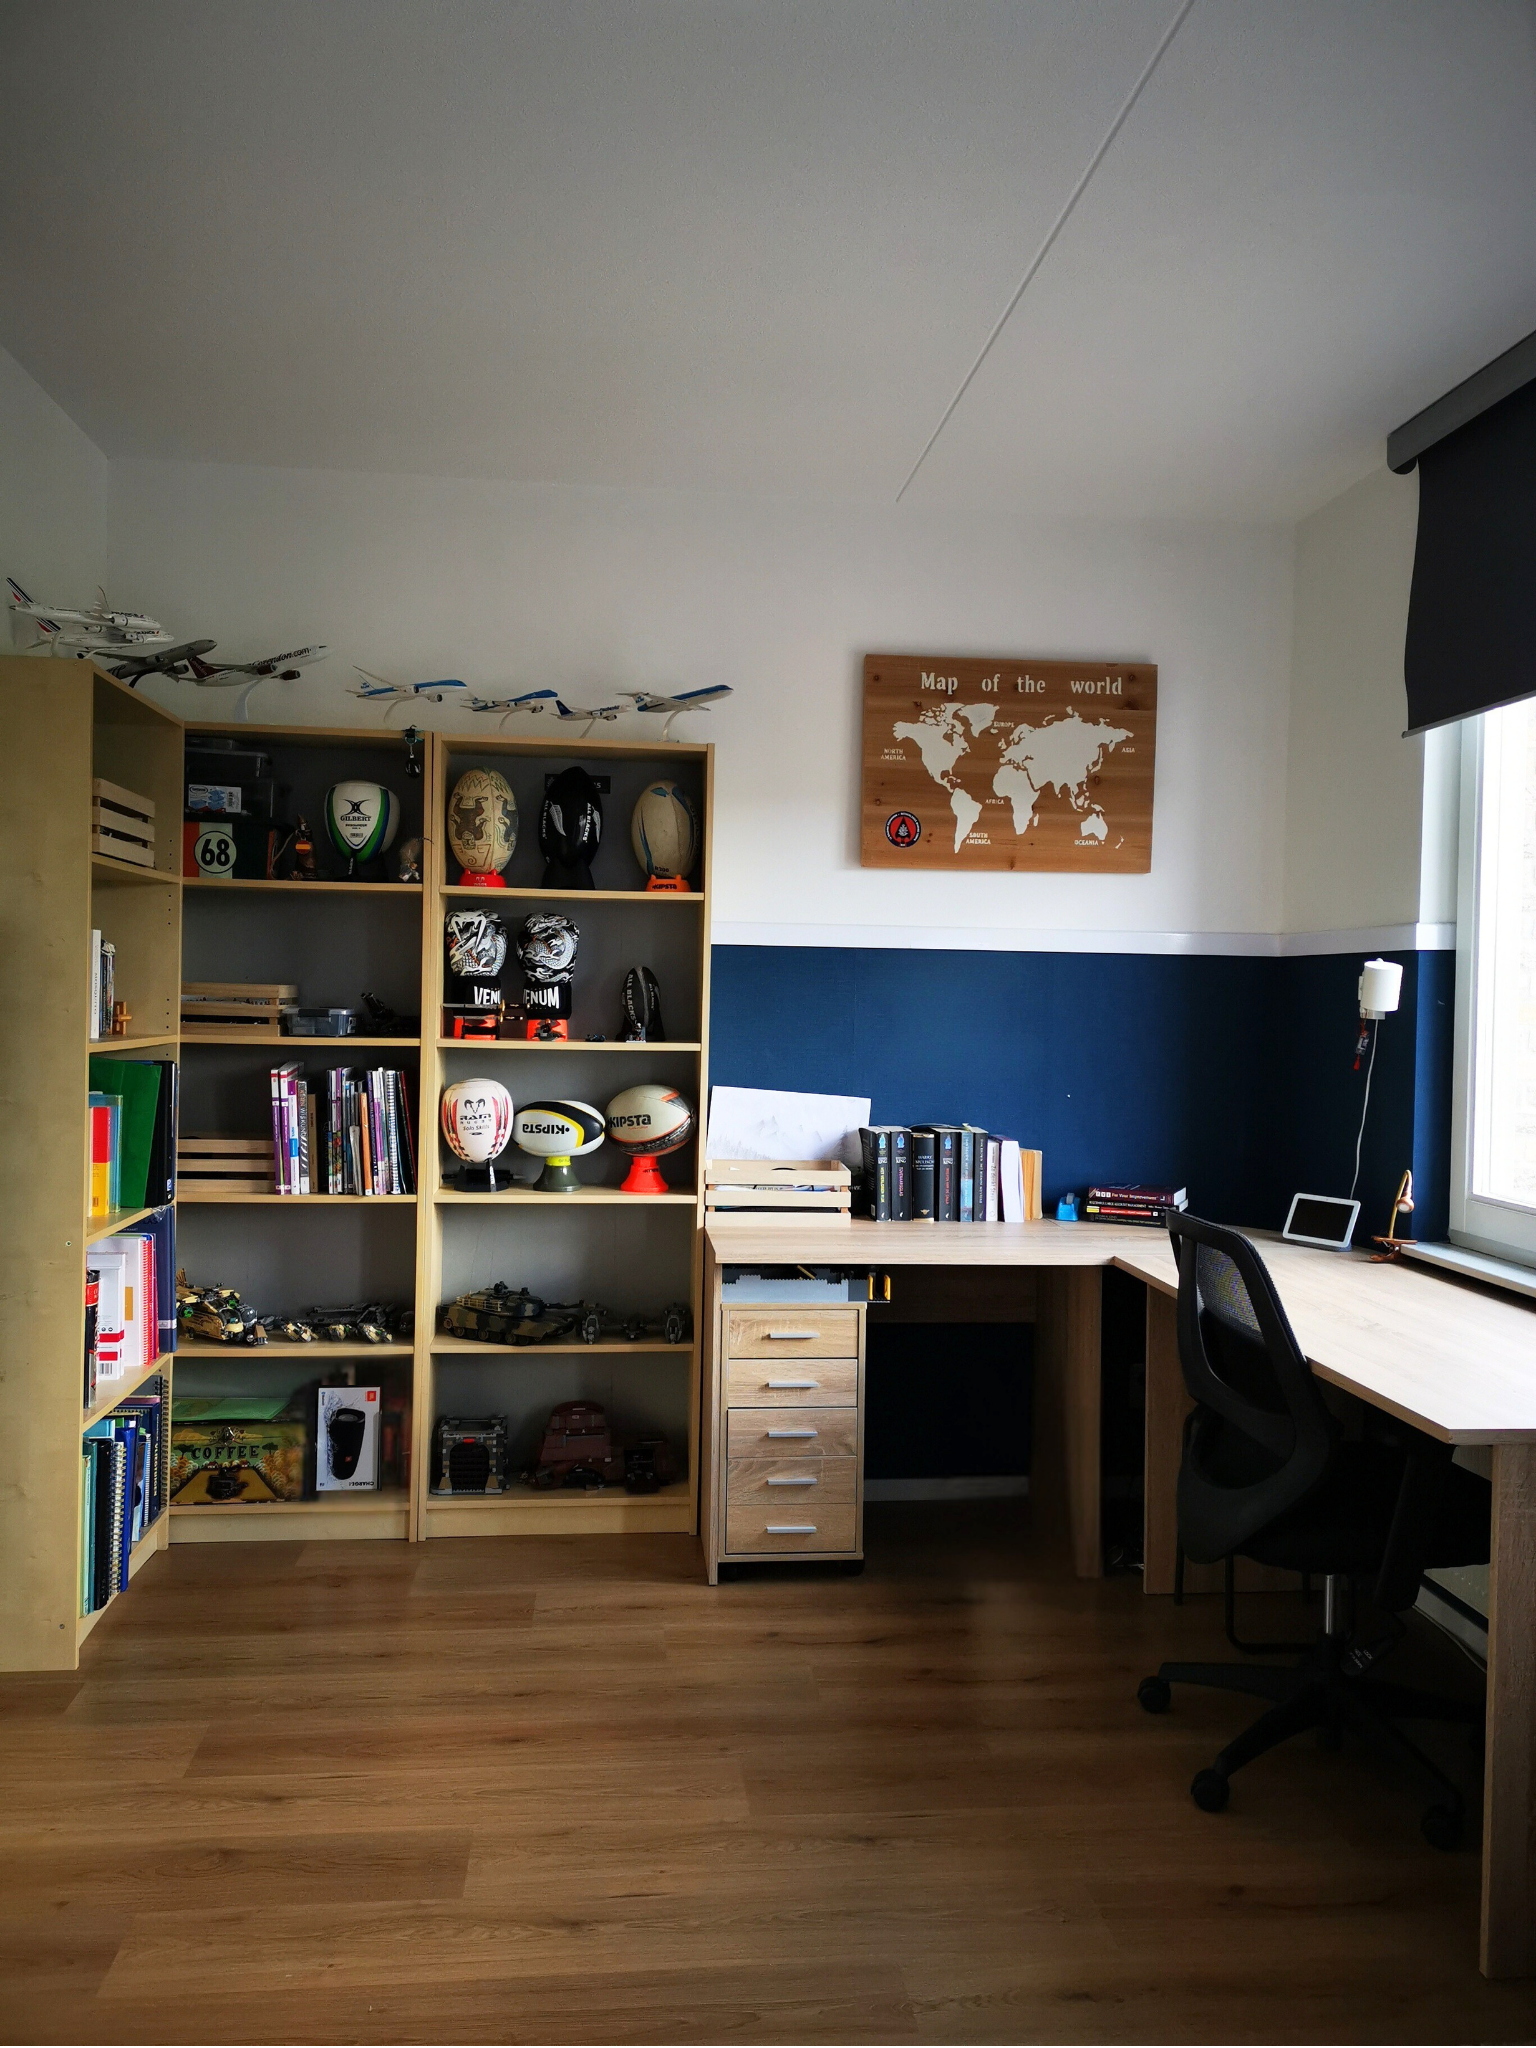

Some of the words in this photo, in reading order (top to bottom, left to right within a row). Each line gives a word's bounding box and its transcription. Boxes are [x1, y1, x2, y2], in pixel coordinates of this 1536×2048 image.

[921, 672, 958, 695] Map
[981, 673, 1000, 692] of
[1017, 675, 1046, 693] the
[1070, 677, 1122, 695] world
[201, 838, 231, 867] 68
[191, 1445, 260, 1460] COFFEE
